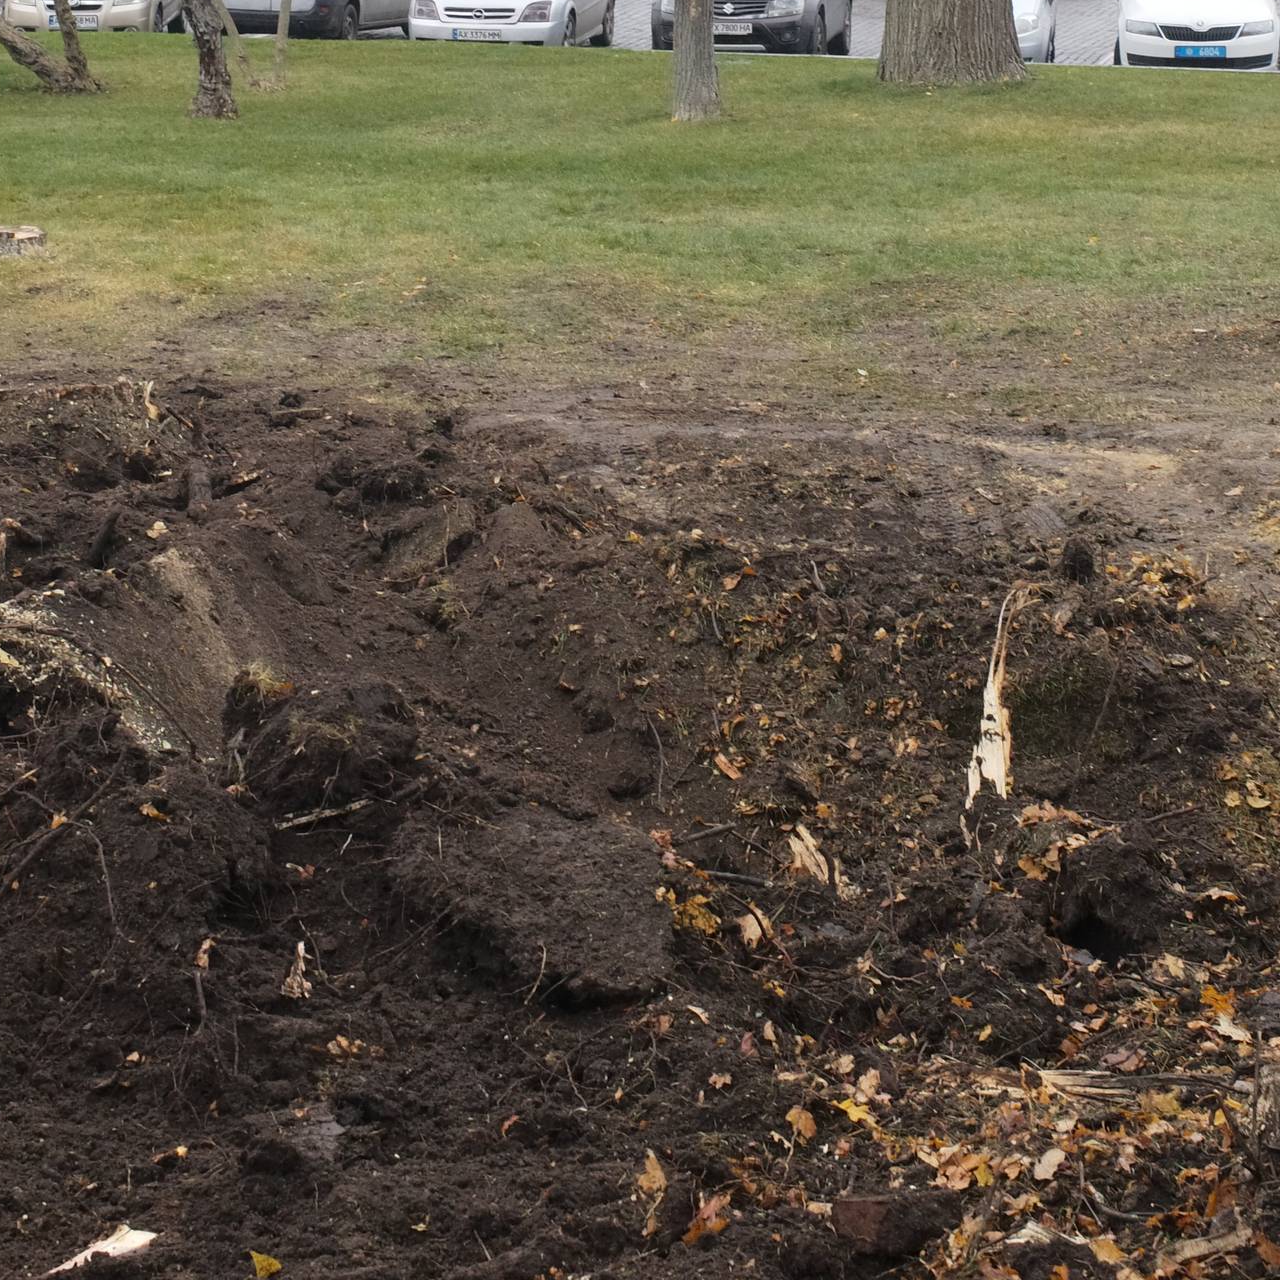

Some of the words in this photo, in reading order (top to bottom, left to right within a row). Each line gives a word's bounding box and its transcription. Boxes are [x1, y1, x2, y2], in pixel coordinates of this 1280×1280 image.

[84, 16, 96, 24] MA
[740, 24, 751, 32] HA
[458, 30, 468, 38] AX
[1199, 47, 1220, 56] 6804
